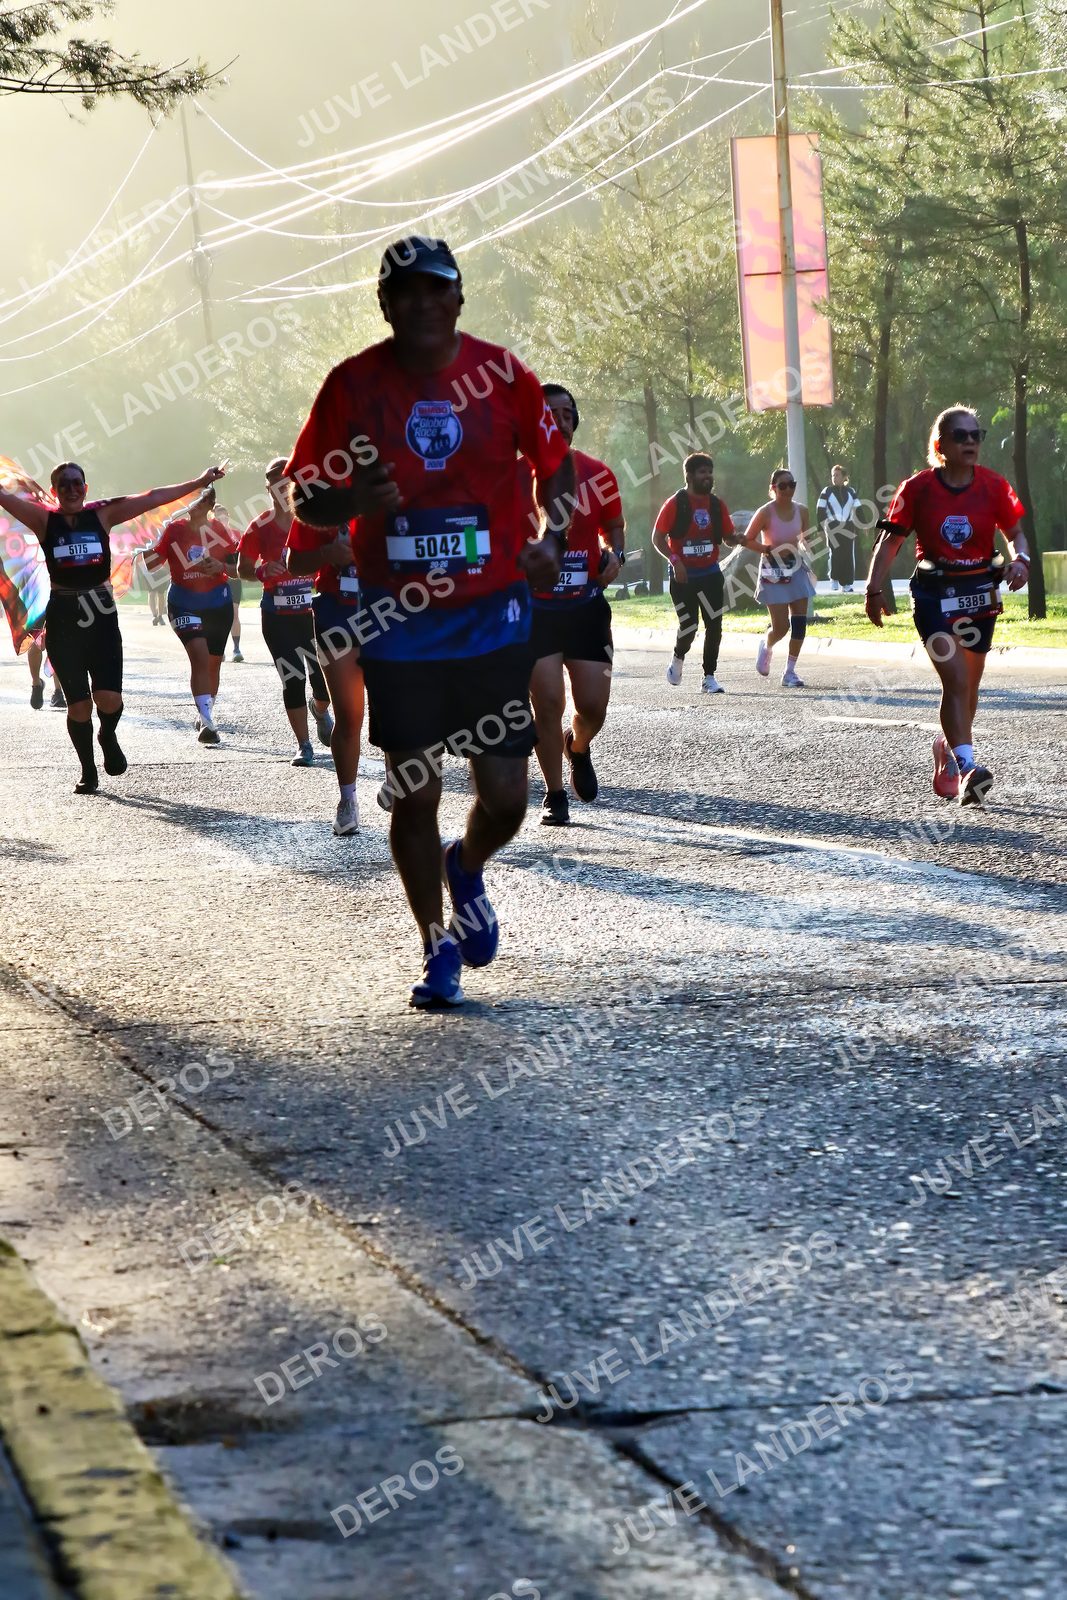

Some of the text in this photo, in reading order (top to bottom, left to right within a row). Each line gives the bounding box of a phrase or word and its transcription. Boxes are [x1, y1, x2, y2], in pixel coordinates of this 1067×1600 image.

[420, 417, 448, 428] Global
[69, 544, 88, 555] 5175
[414, 534, 461, 558] 5042
[286, 595, 306, 605] 3924
[958, 594, 986, 608] 5389
